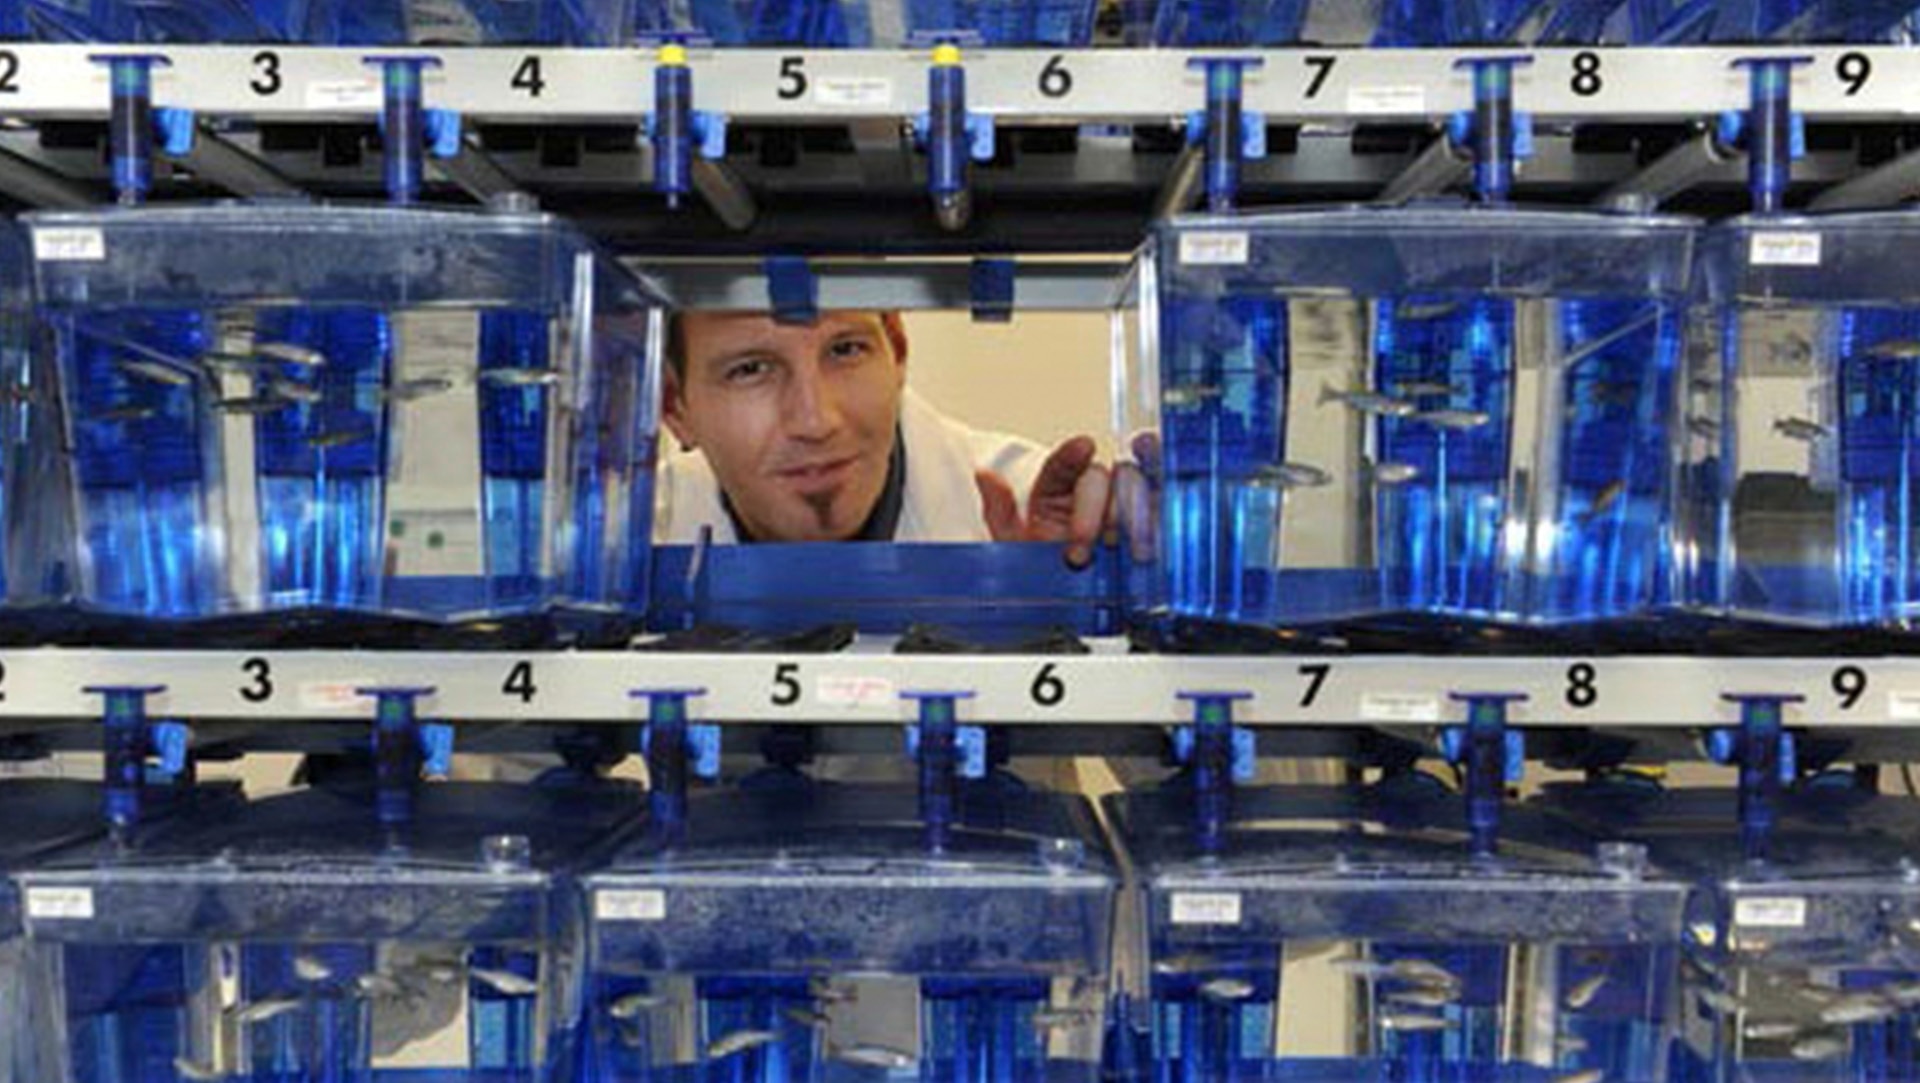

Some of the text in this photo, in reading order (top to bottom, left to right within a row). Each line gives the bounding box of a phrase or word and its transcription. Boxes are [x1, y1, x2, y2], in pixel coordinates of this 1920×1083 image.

[250, 51, 282, 95] 3
[510, 56, 545, 97] 4
[777, 57, 808, 99] 5
[1038, 56, 1073, 98] 6
[1304, 57, 1337, 99] 7
[1570, 52, 1603, 97] 8
[1835, 52, 1872, 96] 9
[239, 657, 273, 702] 3
[501, 660, 537, 704] 4
[771, 663, 801, 706] 5
[1030, 663, 1065, 706] 6
[1297, 663, 1332, 707] 7
[1566, 662, 1598, 708] 8
[1830, 664, 1868, 709] 9
